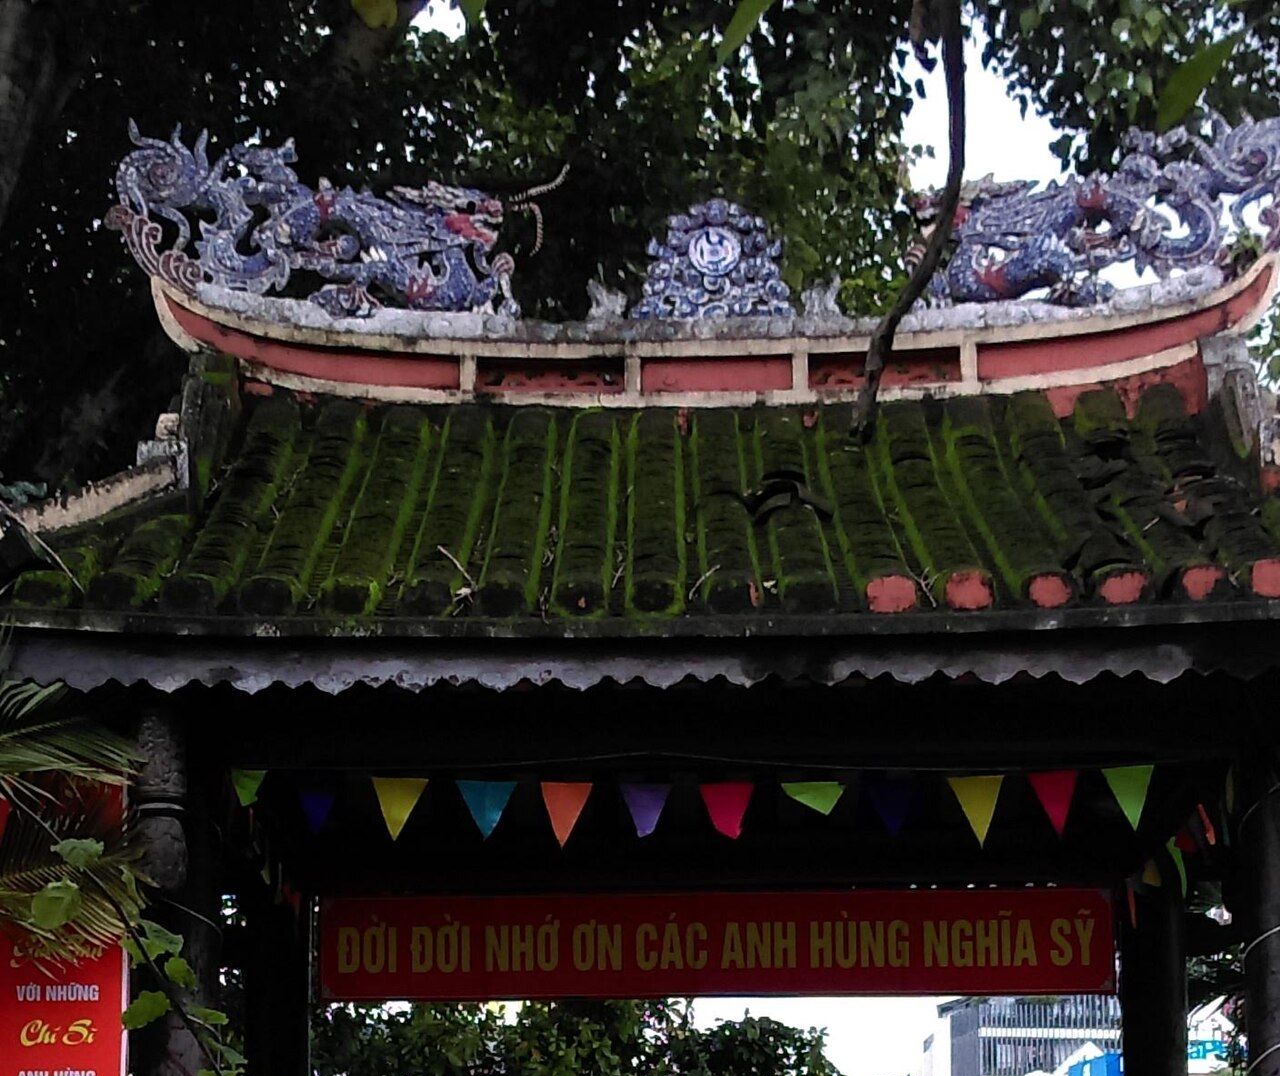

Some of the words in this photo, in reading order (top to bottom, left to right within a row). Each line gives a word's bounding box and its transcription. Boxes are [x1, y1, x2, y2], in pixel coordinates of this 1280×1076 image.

[337, 914, 397, 974] ĐỜI
[410, 913, 471, 974] ĐỜI
[485, 913, 561, 973] NHỚ
[572, 919, 623, 972] ƠN
[635, 912, 708, 970] CÁC
[721, 920, 797, 969] ANH
[809, 910, 910, 968] HÙNG
[923, 909, 1038, 968] NGHĨA
[1050, 908, 1095, 967] SỸ
